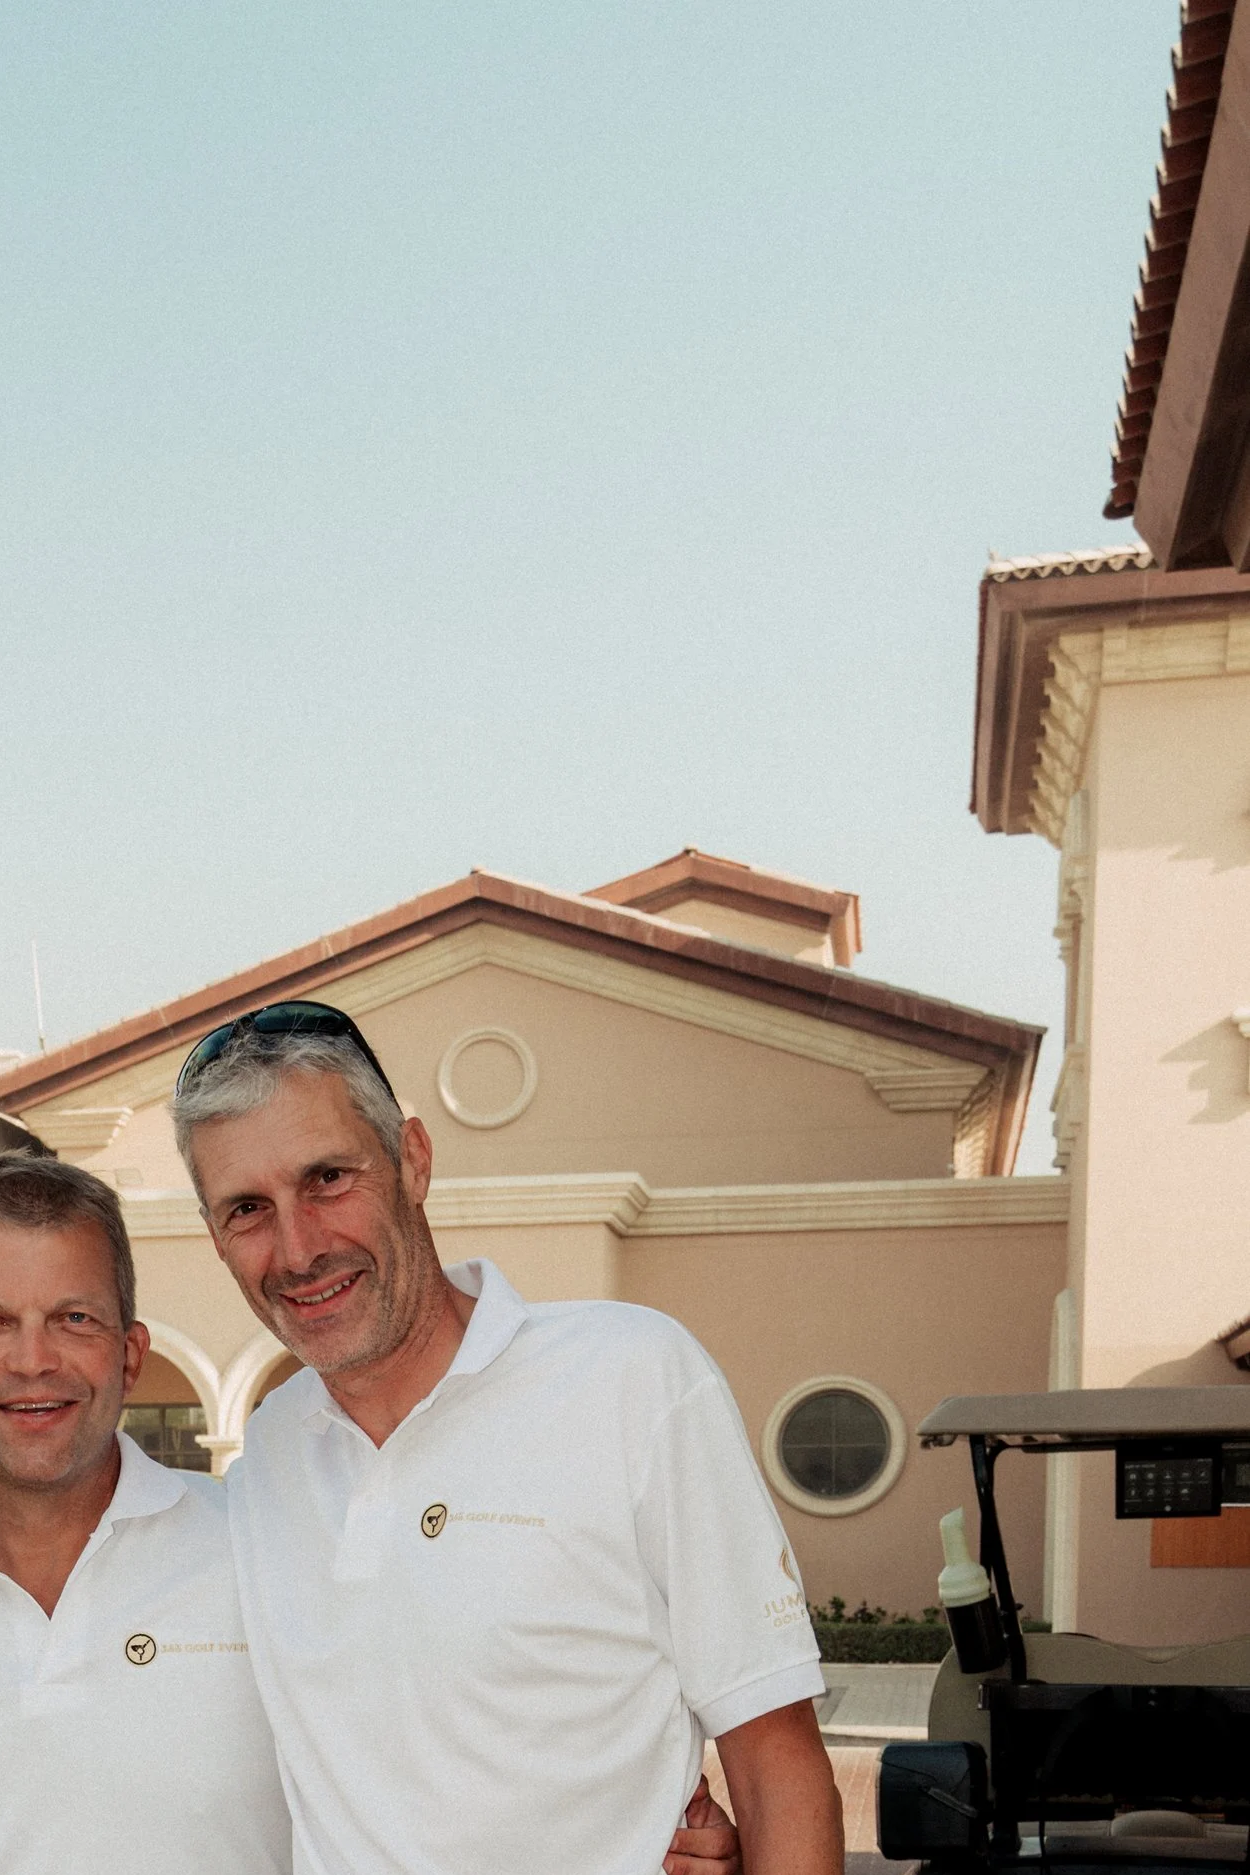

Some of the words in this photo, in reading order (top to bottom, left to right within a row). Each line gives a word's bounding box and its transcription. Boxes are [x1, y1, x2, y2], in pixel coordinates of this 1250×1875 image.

[466, 1511, 497, 1523] GOLF
[499, 1513, 547, 1528] EVENTS
[764, 1592, 803, 1617] JUM
[185, 1643, 215, 1653] GOLF
[218, 1642, 249, 1653] EVEN
